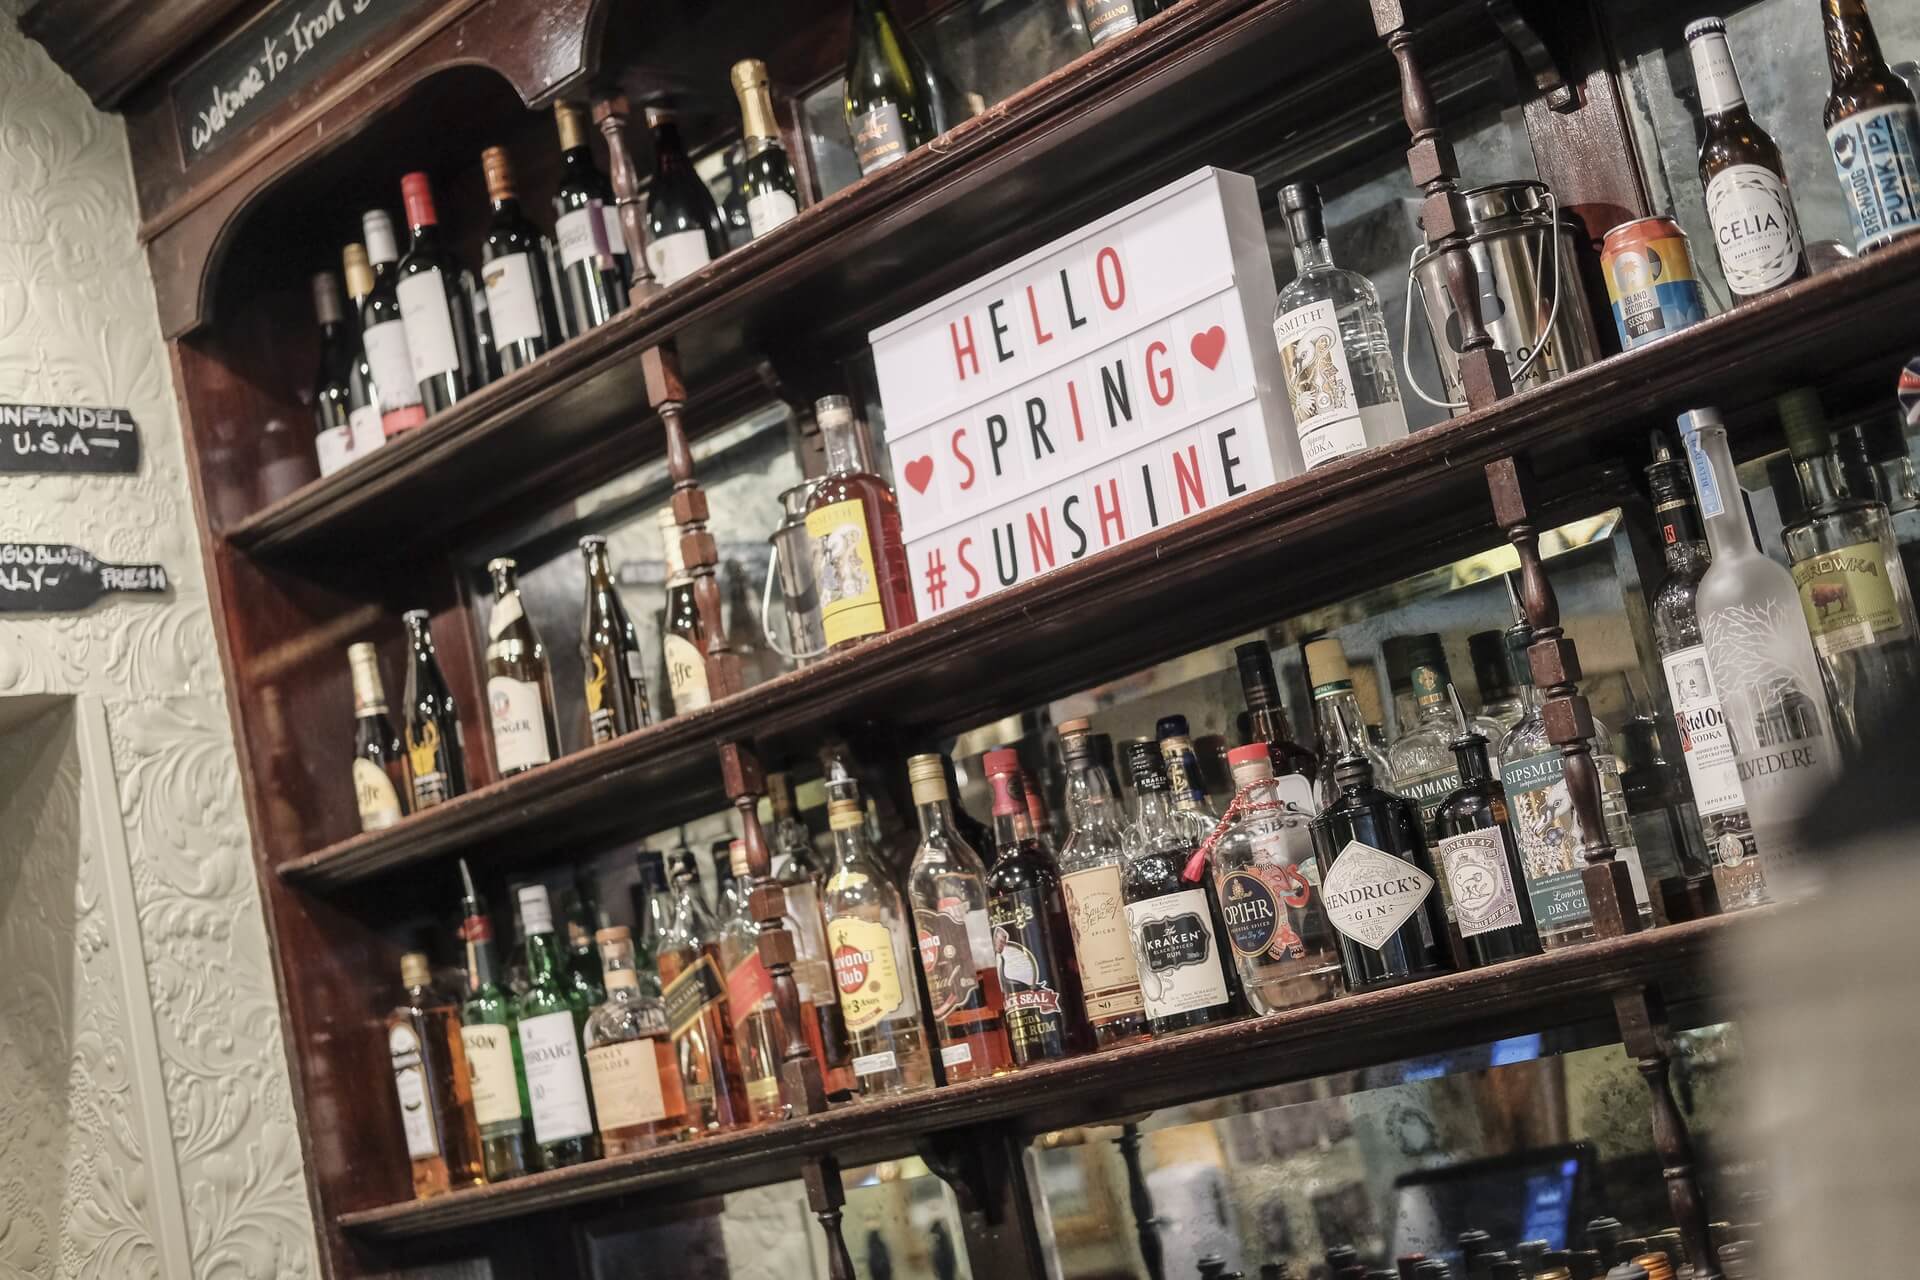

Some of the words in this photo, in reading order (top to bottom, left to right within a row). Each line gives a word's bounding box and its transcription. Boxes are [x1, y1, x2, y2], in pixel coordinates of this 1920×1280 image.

[261, 36, 288, 81] to
[1864, 115, 1890, 157] IPA
[1873, 158, 1910, 228] PUNK
[1850, 167, 1882, 239] BREWDOG
[1719, 212, 1780, 245] CELIA
[1624, 290, 1648, 306] ISLAND
[1624, 298, 1654, 316] RECORDS
[949, 246, 1126, 381] HELLO
[1627, 310, 1655, 329] SESSION
[1636, 323, 1650, 336] IPA
[1517, 370, 1540, 382] DKA
[0, 405, 134, 432] INFANDEL
[950, 340, 1175, 490] SPRING
[925, 427, 1247, 612] #SUNSHINE
[100, 566, 166, 591] FRESH
[1691, 730, 1723, 745] VODKA
[1505, 758, 1565, 785] SIPSMIT
[1704, 793, 1738, 806] IMPORTED
[1479, 839, 1492, 847] 47
[1325, 875, 1422, 911] HENDRICK'S
[1553, 887, 1584, 902] London
[1223, 898, 1273, 926] OPIHR
[1354, 905, 1387, 921] GIN
[1547, 900, 1570, 915] DRY
[1572, 897, 1587, 909] GI
[1146, 931, 1200, 951] KRAKEN
[1166, 950, 1181, 959] RUM
[851, 999, 860, 1013] 3
[1019, 992, 1049, 1006] SEAL
[1030, 1020, 1057, 1036] RUM
